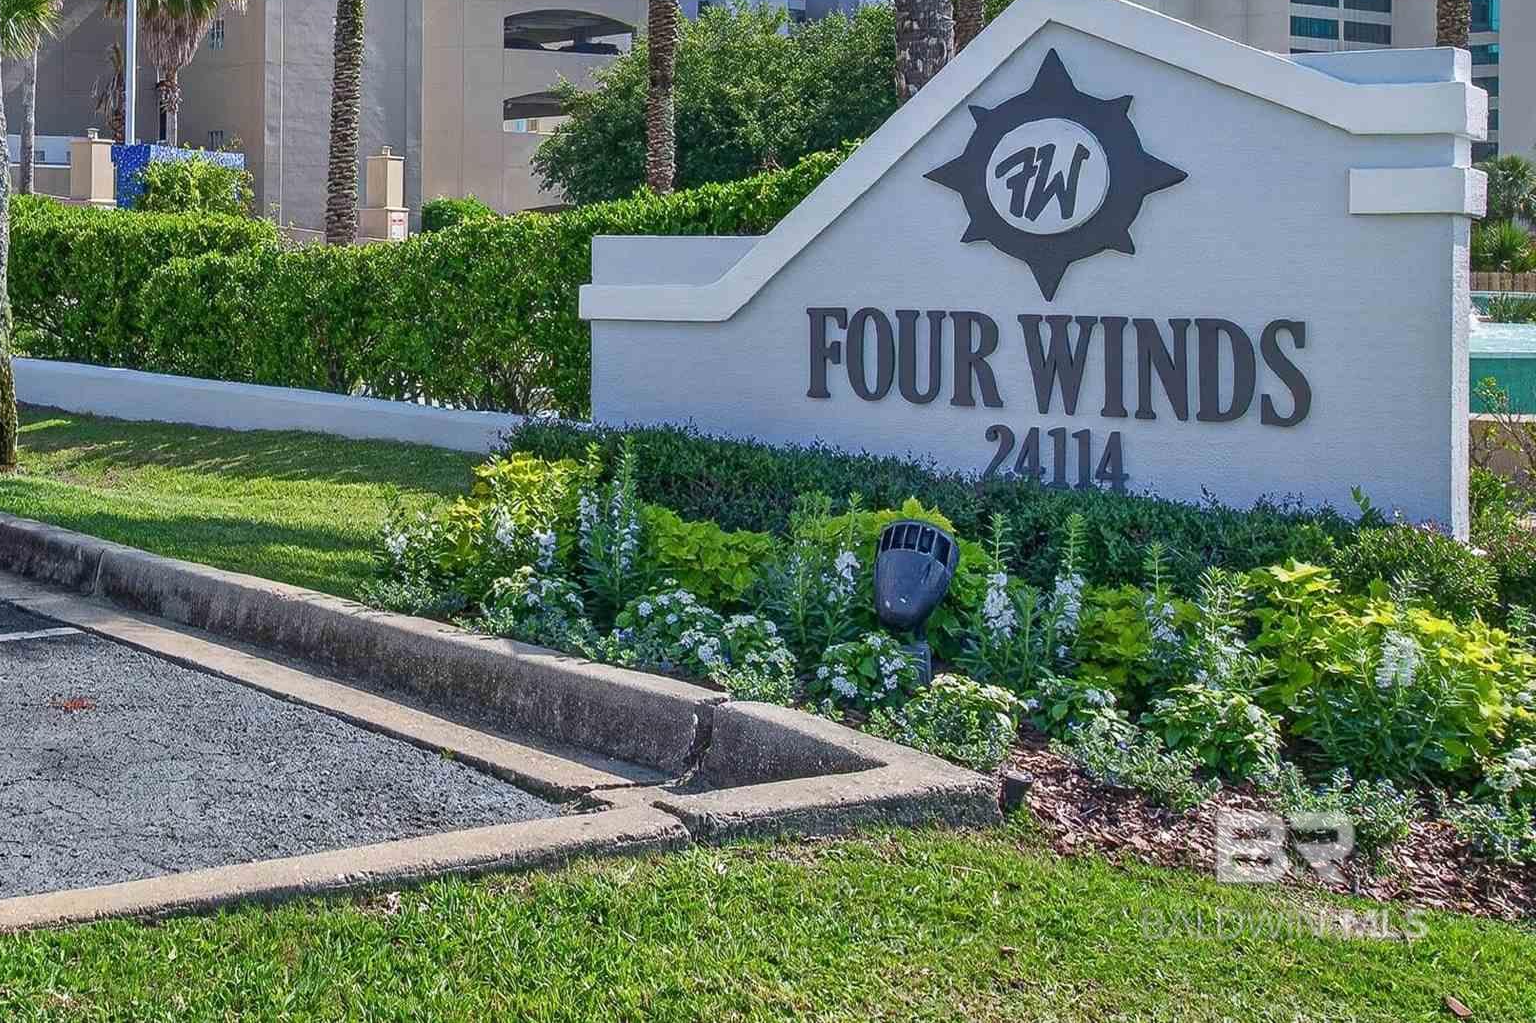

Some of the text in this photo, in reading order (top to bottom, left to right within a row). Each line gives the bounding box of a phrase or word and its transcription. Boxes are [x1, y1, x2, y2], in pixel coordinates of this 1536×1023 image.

[805, 306, 1313, 428] FOUR WINDS
[981, 423, 1131, 494] 24114
